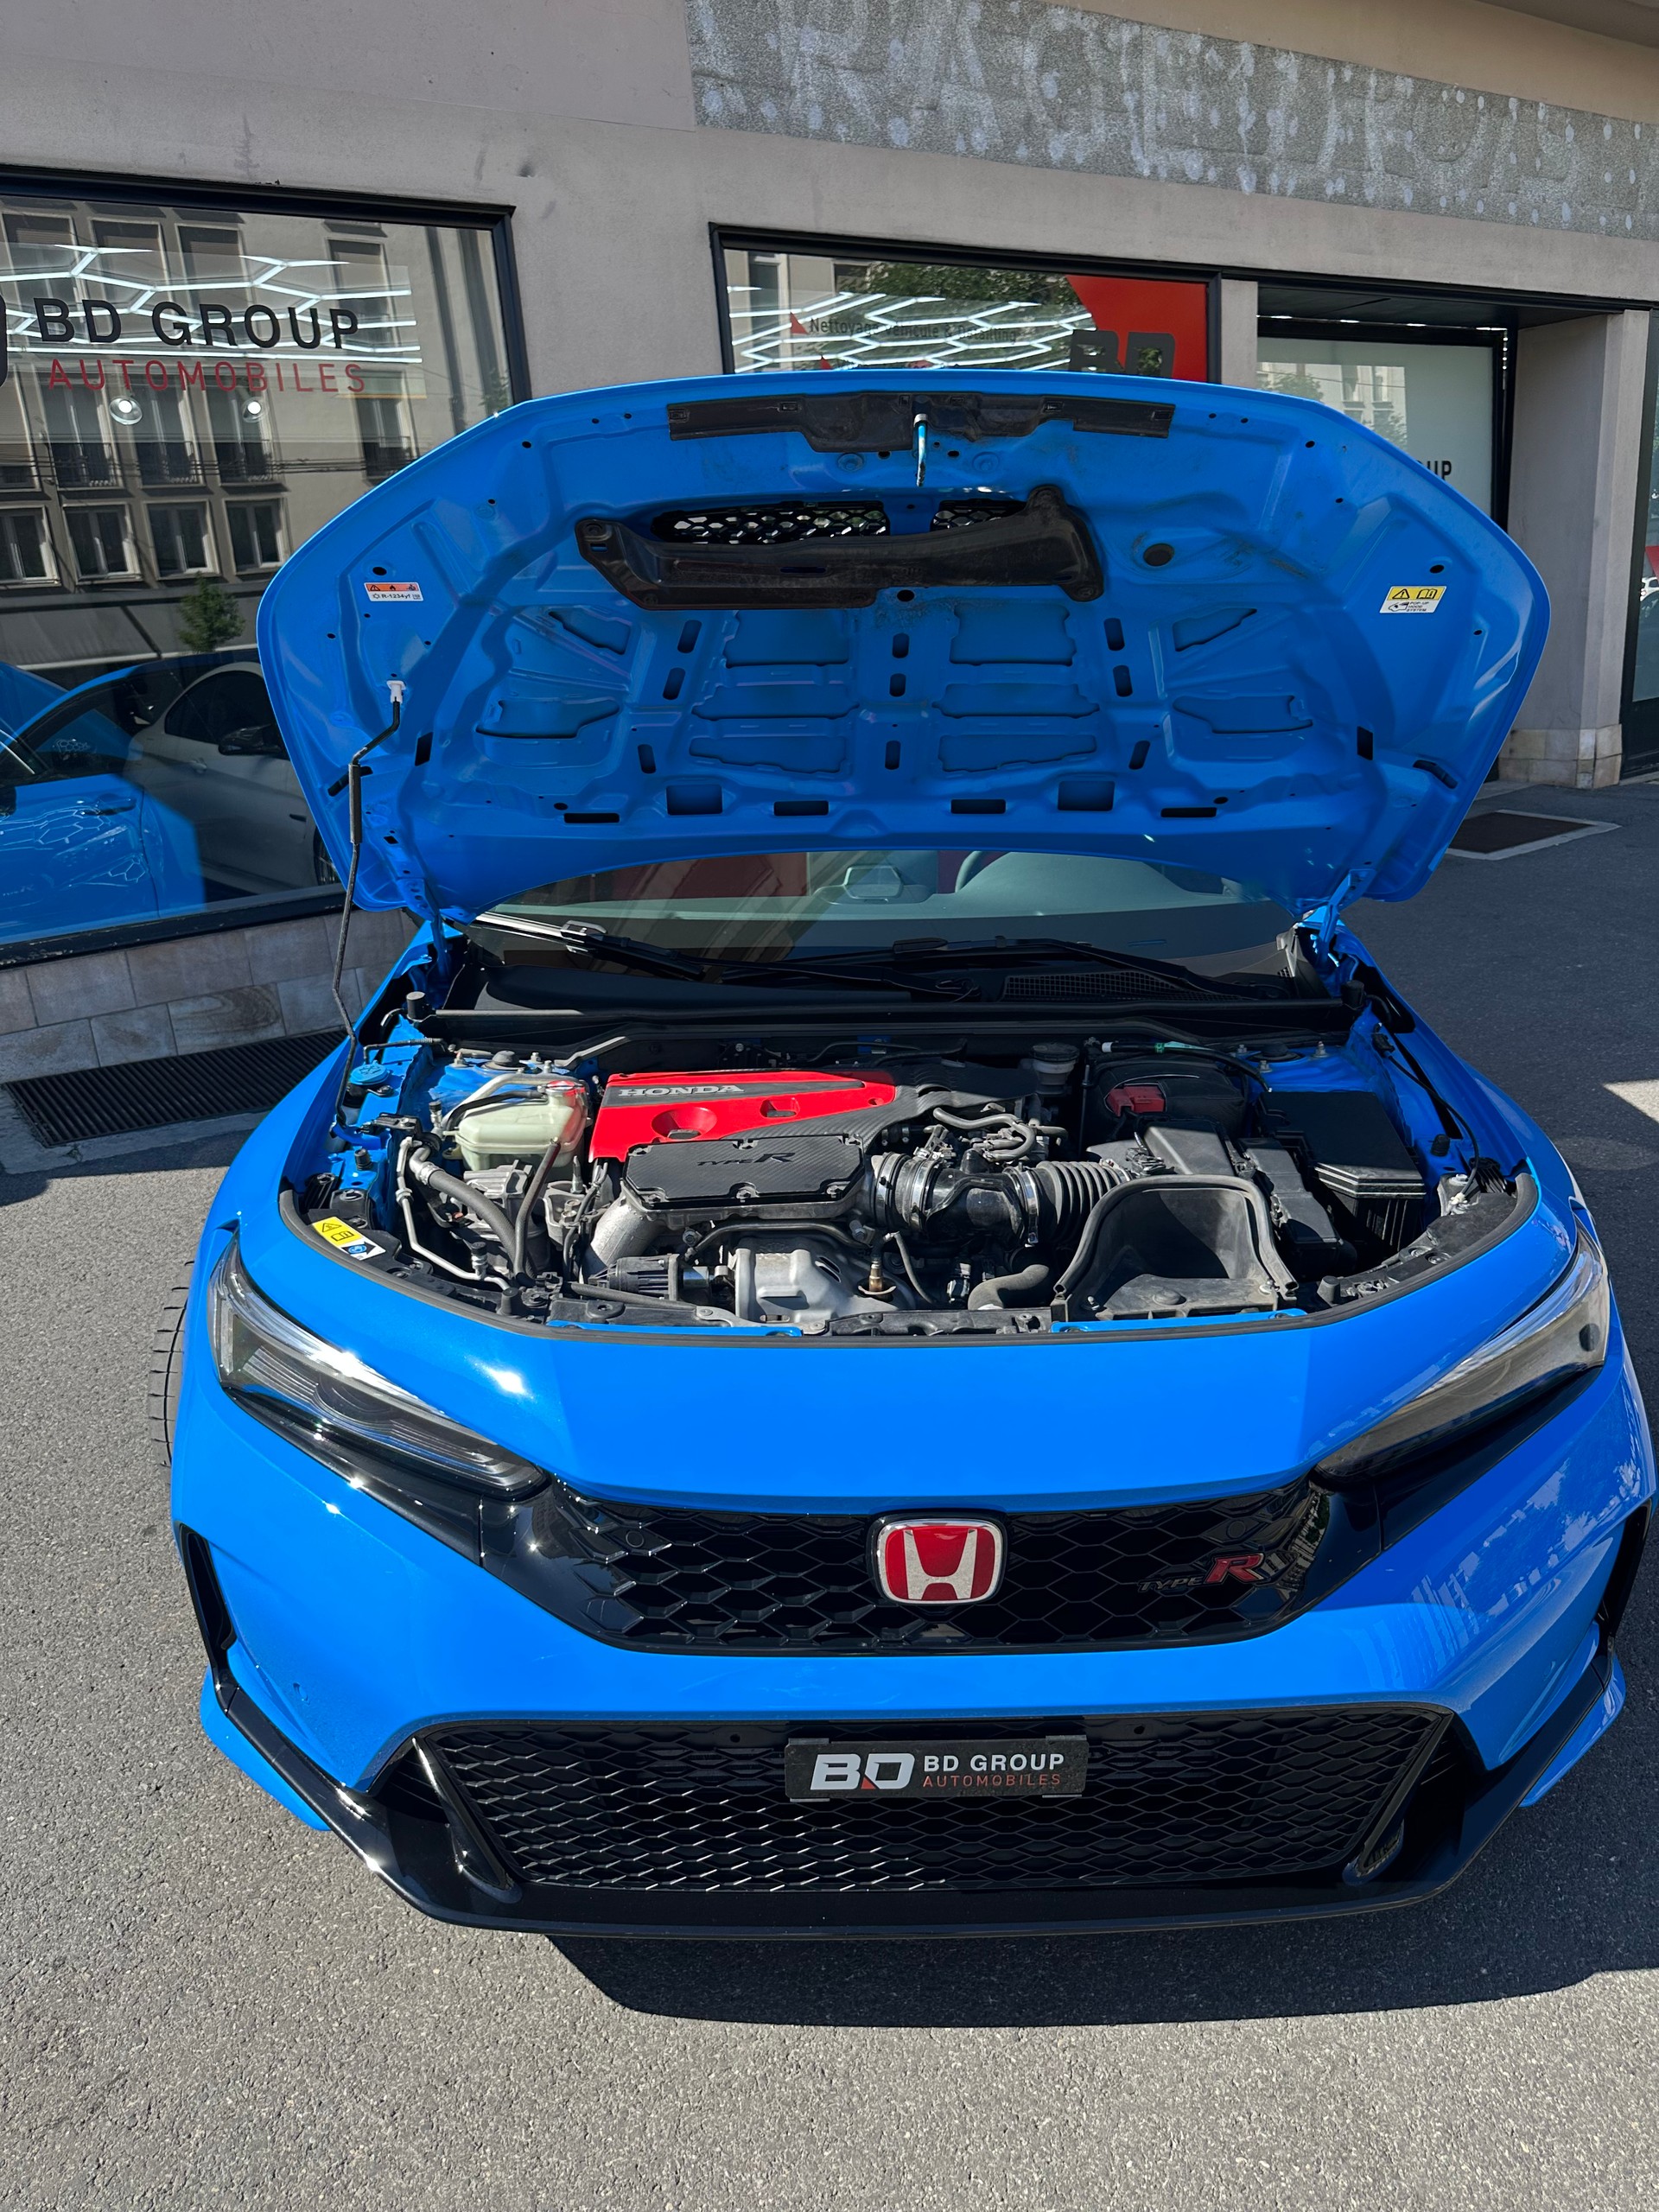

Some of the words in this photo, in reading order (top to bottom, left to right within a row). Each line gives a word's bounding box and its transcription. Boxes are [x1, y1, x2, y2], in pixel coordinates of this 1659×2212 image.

[33, 297, 123, 343] BD
[152, 301, 359, 349] GROUP
[48, 358, 365, 393] AUTOMOBILES
[618, 1084, 745, 1097] HONDA
[753, 1152, 796, 1164] R
[1139, 1577, 1205, 1592] TYPE
[1205, 1553, 1265, 1584] R
[923, 1755, 959, 1772] BD
[969, 1753, 1065, 1771] GROUP
[922, 1774, 1061, 1788] AUTOMOBILES
